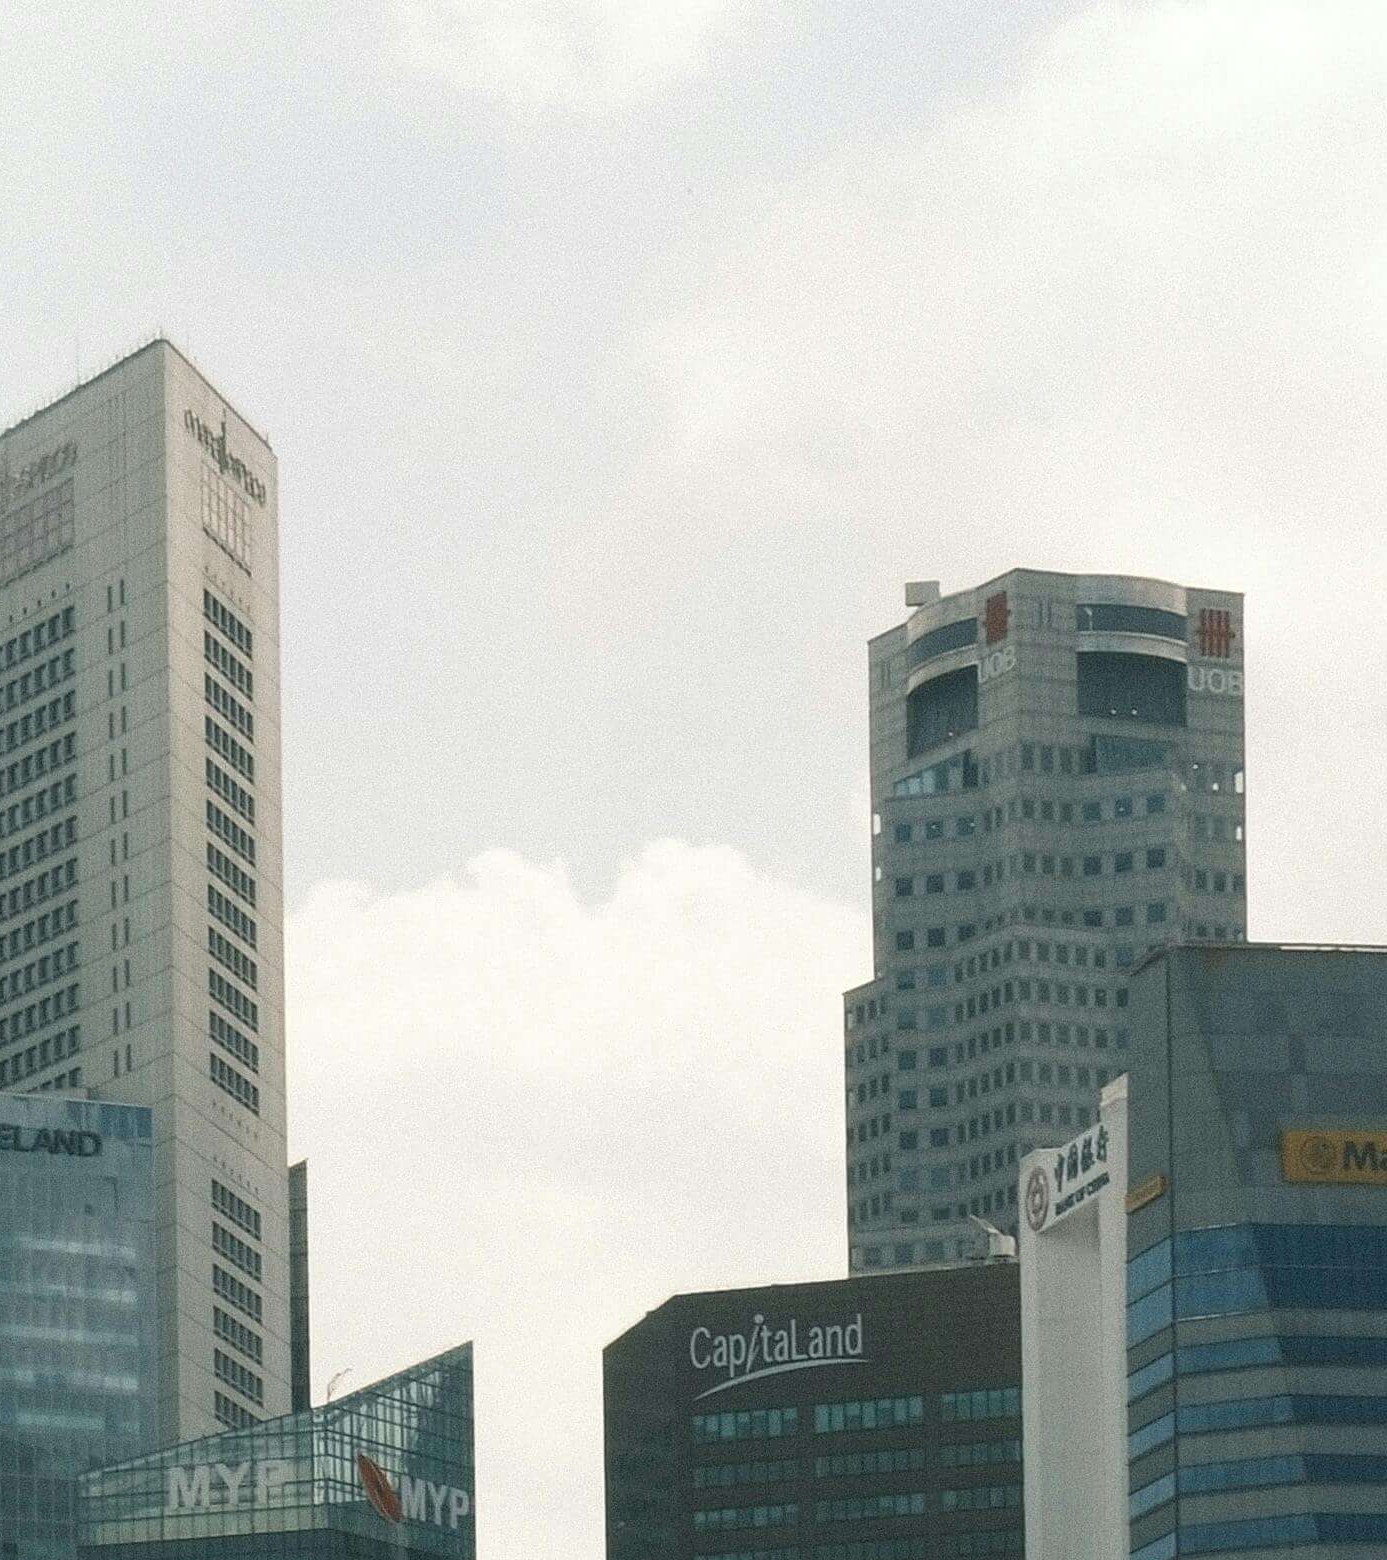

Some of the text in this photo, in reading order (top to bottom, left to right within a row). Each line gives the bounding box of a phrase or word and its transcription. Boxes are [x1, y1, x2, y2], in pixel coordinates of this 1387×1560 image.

[690, 1313, 863, 1379] CapitaLand
[166, 1458, 289, 1510] MYP
[400, 1475, 470, 1530] MYP
